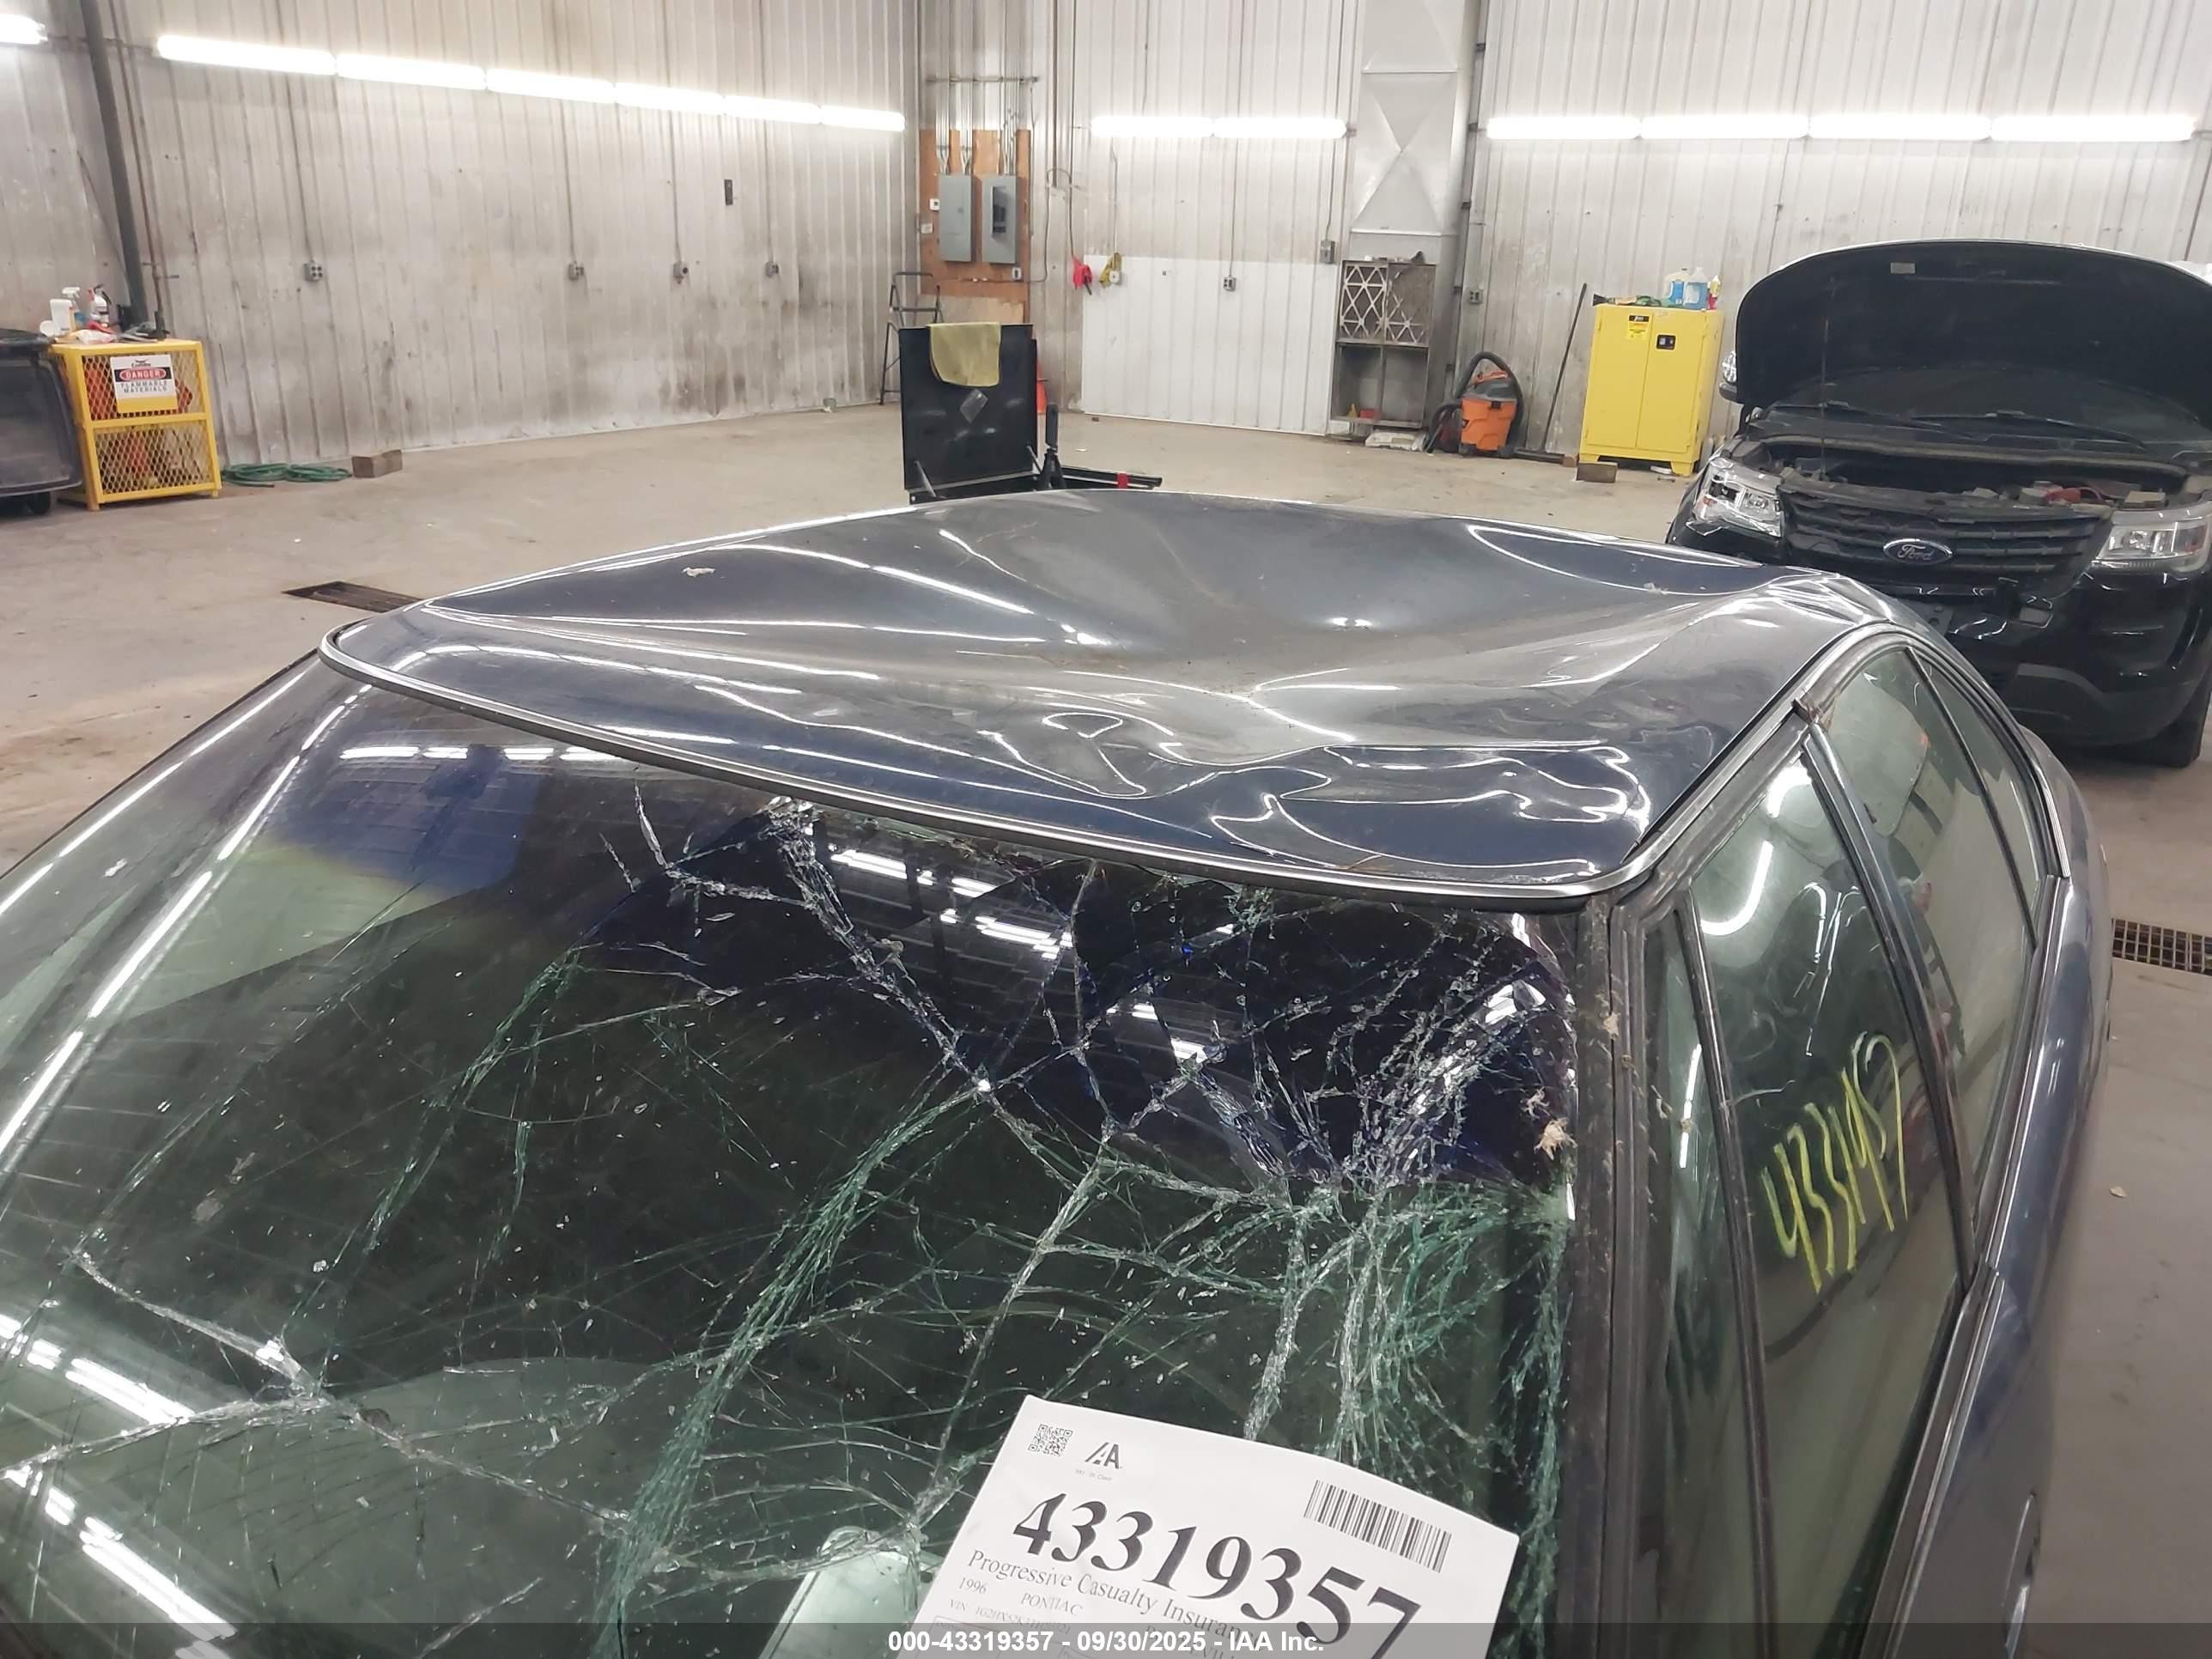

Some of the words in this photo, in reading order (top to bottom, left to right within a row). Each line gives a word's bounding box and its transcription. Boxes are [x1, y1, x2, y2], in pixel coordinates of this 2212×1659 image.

[125, 370, 161, 379] DANGER
[958, 1577, 988, 1595] 1996
[968, 1549, 1073, 1587] Progressive
[1078, 1572, 1158, 1615] Casualty
[1012, 1492, 1422, 1659] 43319357
[1020, 1592, 1083, 1616] PONTIAC
